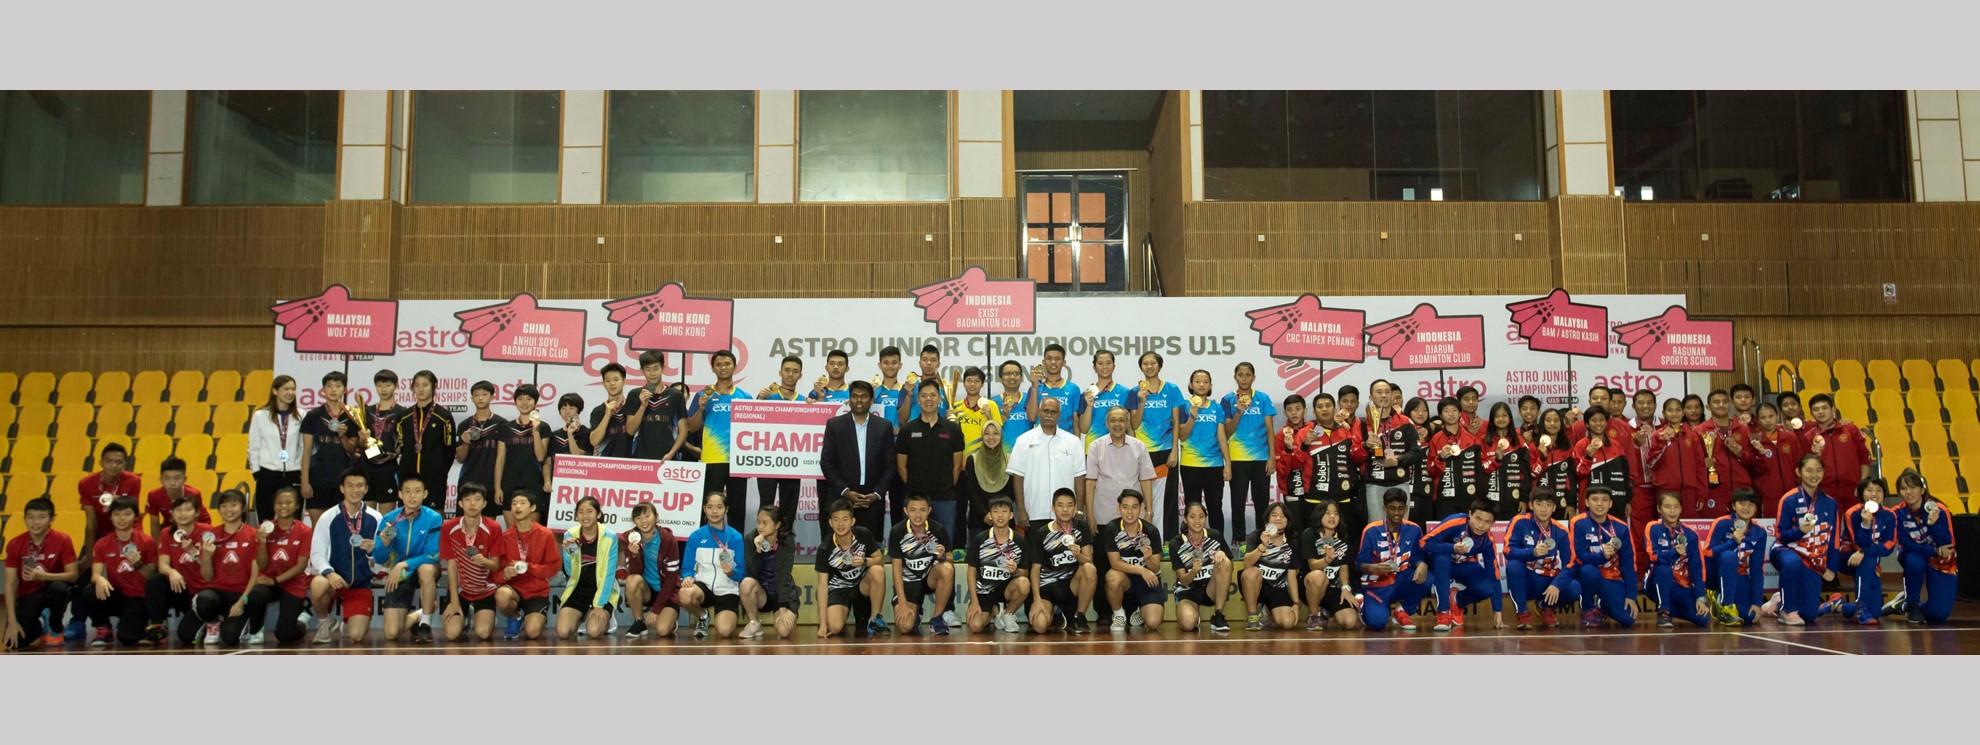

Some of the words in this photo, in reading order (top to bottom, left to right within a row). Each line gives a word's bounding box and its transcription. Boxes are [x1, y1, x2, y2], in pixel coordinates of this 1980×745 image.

[965, 295, 1012, 306] INDONESIA
[659, 312, 683, 323] HONG
[686, 313, 711, 325] KONG
[978, 308, 998, 318] EXIST
[327, 314, 371, 326] MALAYSIA
[956, 318, 1000, 328] BADMINTON
[1002, 318, 1021, 328] CLUB
[1553, 315, 1588, 329] MALAYSIA
[327, 327, 347, 338] WOLF
[350, 328, 370, 339] TEAM
[523, 322, 551, 335] CHINA
[662, 325, 683, 336] HONG
[685, 326, 706, 337] KONG
[1300, 321, 1341, 334] MALAYSIA
[396, 326, 469, 348] astro
[1286, 333, 1300, 343] CRC
[1302, 334, 1326, 345] TAIPEX
[1327, 336, 1355, 347] PENANG
[1417, 331, 1462, 343] INDONESIA
[1542, 326, 1556, 337] BAM
[1561, 329, 1580, 340] ASTRO
[1581, 331, 1599, 342] KASIH
[1667, 333, 1712, 345] INDONESIA
[513, 336, 537, 347] ANHUI
[539, 337, 559, 348] SOYU
[769, 337, 859, 358] ASTRO
[866, 336, 960, 357] JUNIOR
[1189, 335, 1236, 356] U15
[502, 345, 547, 358] BADMINTON
[549, 348, 569, 359] CLUB
[1425, 344, 1454, 354] DJARUM
[1672, 346, 1706, 357] RAGUNAN
[1409, 353, 1451, 364] BADMINTON
[1453, 353, 1471, 363] CLUB
[1661, 356, 1688, 366] SPORTS
[1690, 356, 1718, 366] SCHOOL
[1506, 371, 1539, 382] ASTRO
[1593, 371, 1663, 393] astro
[435, 378, 468, 390] UNIOR
[774, 406, 820, 414] CHAMPIONSHIPS
[1093, 400, 1119, 409] exist
[1008, 412, 1029, 421] xist
[1242, 407, 1261, 415] xist
[736, 431, 824, 453] CHAMP
[576, 461, 597, 469] JUNIOR
[598, 462, 642, 471] CHAMPIONSHIPS
[736, 455, 798, 468] USD5,000
[557, 468, 588, 476] (REGIONAL)
[663, 466, 701, 480] astro
[556, 485, 694, 511] RUNNER-UP
[906, 559, 929, 569] aiPe
[980, 567, 1010, 579] TaiPe
